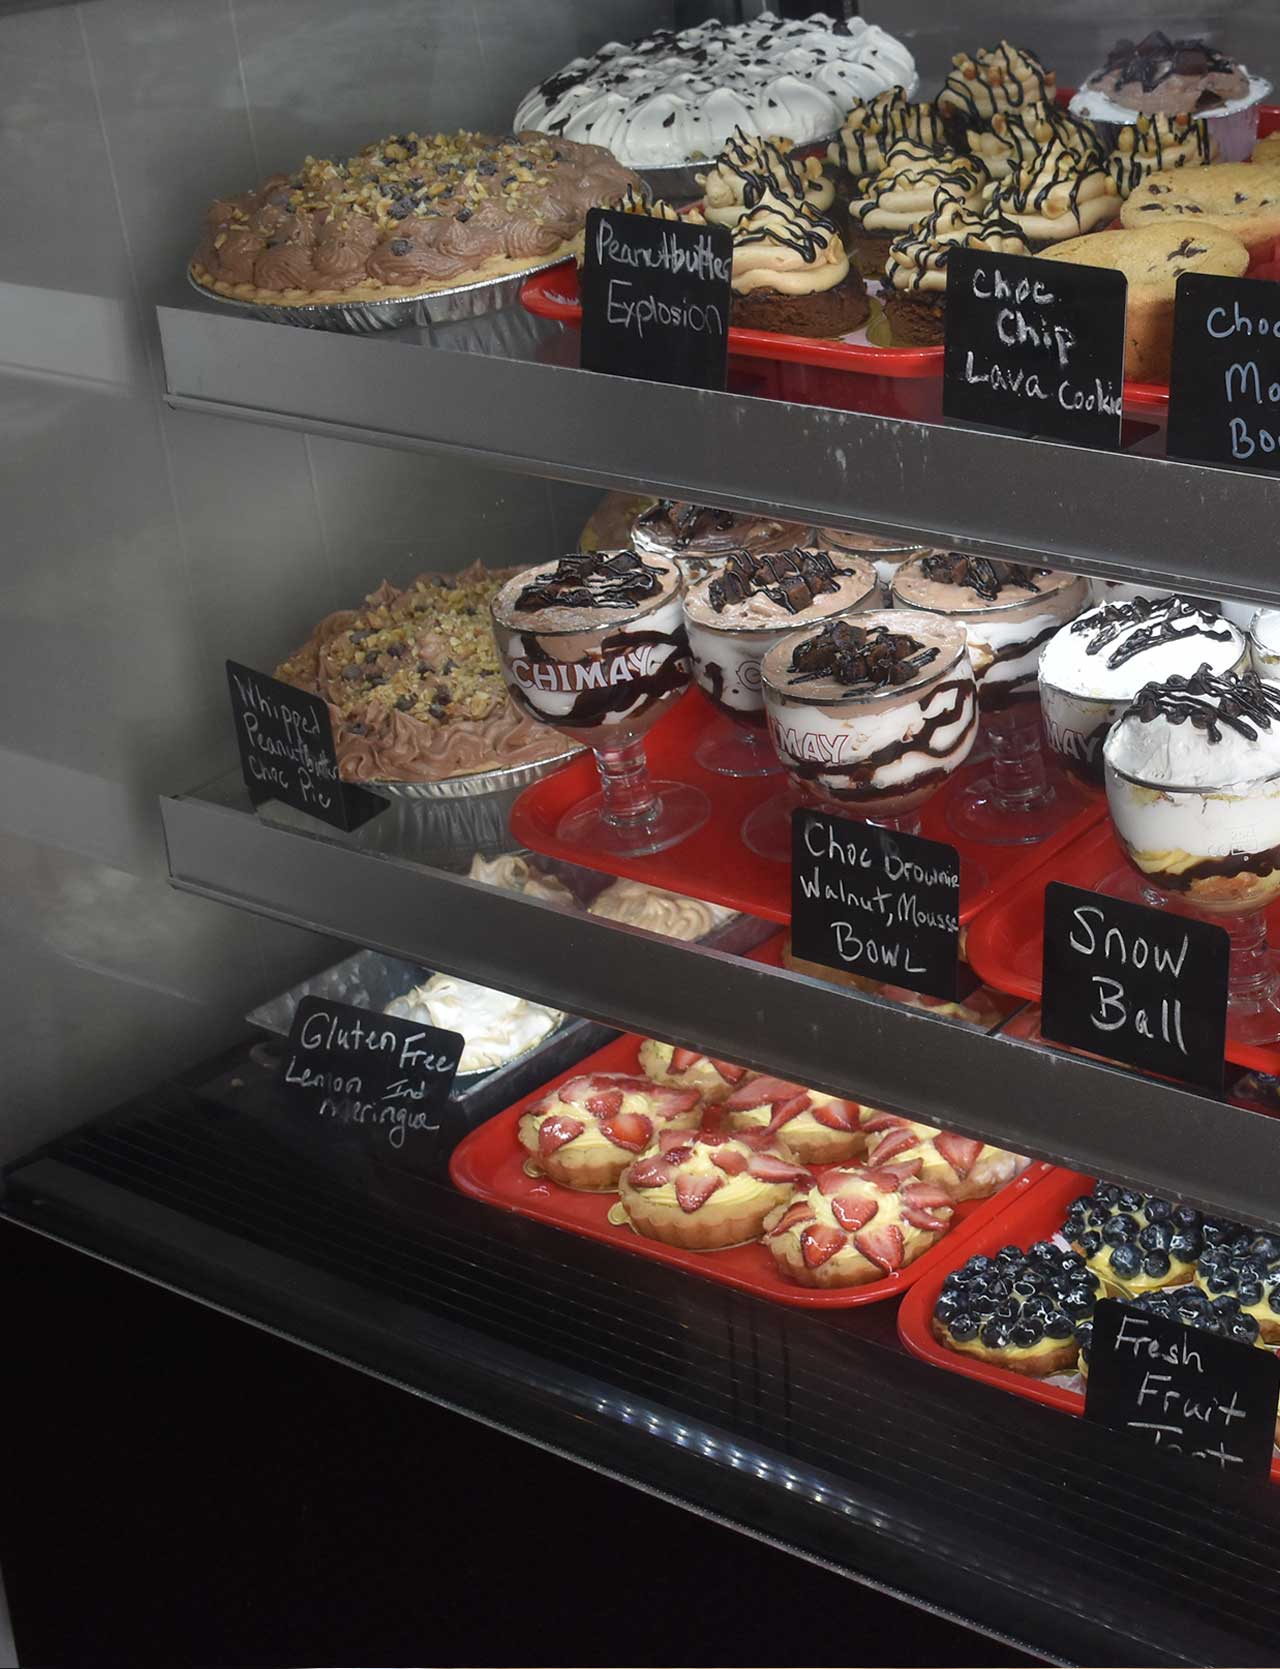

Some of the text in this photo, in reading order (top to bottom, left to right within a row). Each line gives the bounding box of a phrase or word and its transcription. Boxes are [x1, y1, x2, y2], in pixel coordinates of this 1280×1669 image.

[607, 279, 723, 338] Explosion
[997, 308, 1076, 368] Chip
[965, 350, 1048, 399] Lava
[511, 643, 653, 693] CHIMAY
[233, 674, 321, 744] Whipped
[772, 717, 848, 764] MAY
[1044, 714, 1101, 764] MAY
[247, 754, 289, 789] Choc
[297, 766, 332, 809] Pie
[804, 822, 872, 868] Choc
[897, 892, 959, 932] Mousse
[1068, 904, 1189, 978] Snow
[1089, 975, 1188, 1056] Ball
[301, 1012, 455, 1073] Gluten Free
[284, 1055, 426, 1101] Lemon Ind
[1114, 1314, 1204, 1374] Fresh
[1136, 1370, 1247, 1427] Fruit
[1126, 1421, 1245, 1470] Tt
